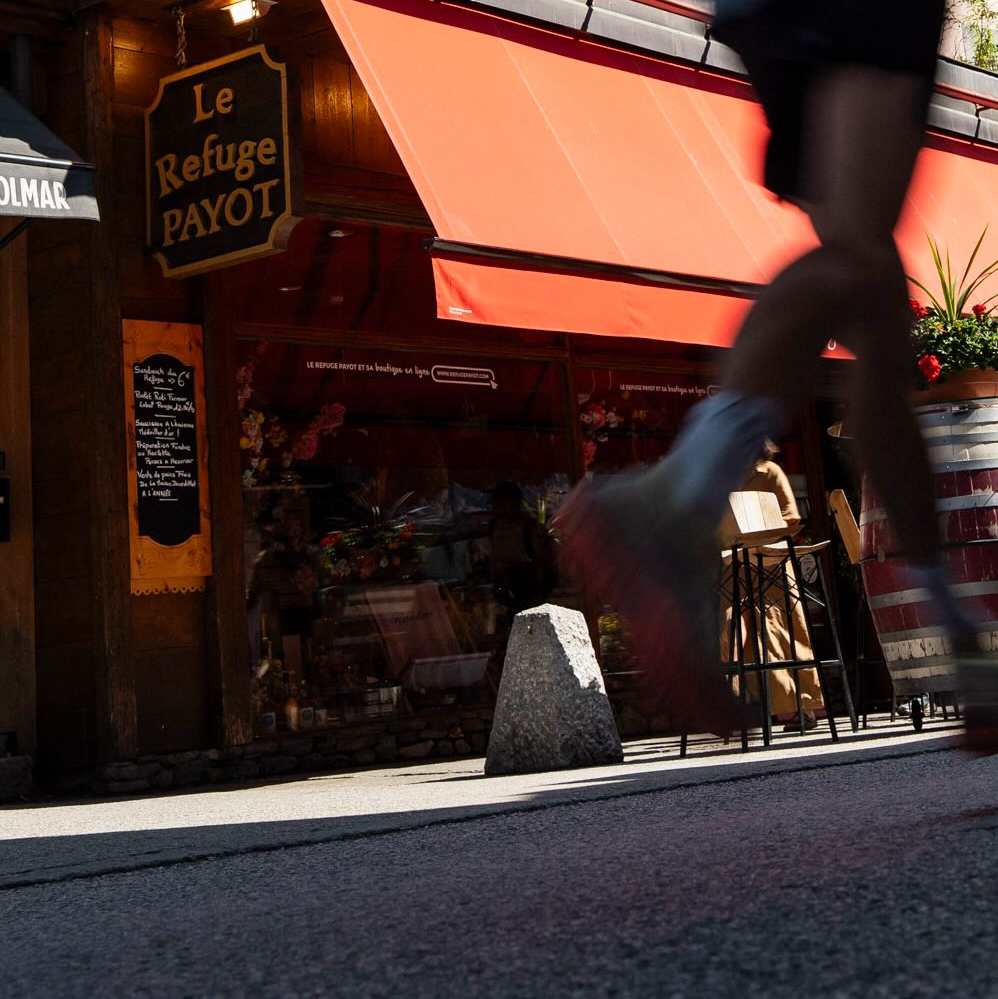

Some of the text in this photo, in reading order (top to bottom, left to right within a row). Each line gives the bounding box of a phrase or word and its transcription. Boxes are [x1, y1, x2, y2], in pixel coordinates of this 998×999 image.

[193, 82, 235, 123] Le
[155, 133, 277, 198] Refuge
[162, 179, 280, 247] PAYOT
[306, 361, 314, 369] LE
[315, 362, 338, 370] REFUGE
[339, 363, 357, 371] PAYOT
[375, 362, 402, 376] boutique
[415, 365, 430, 378] ligne
